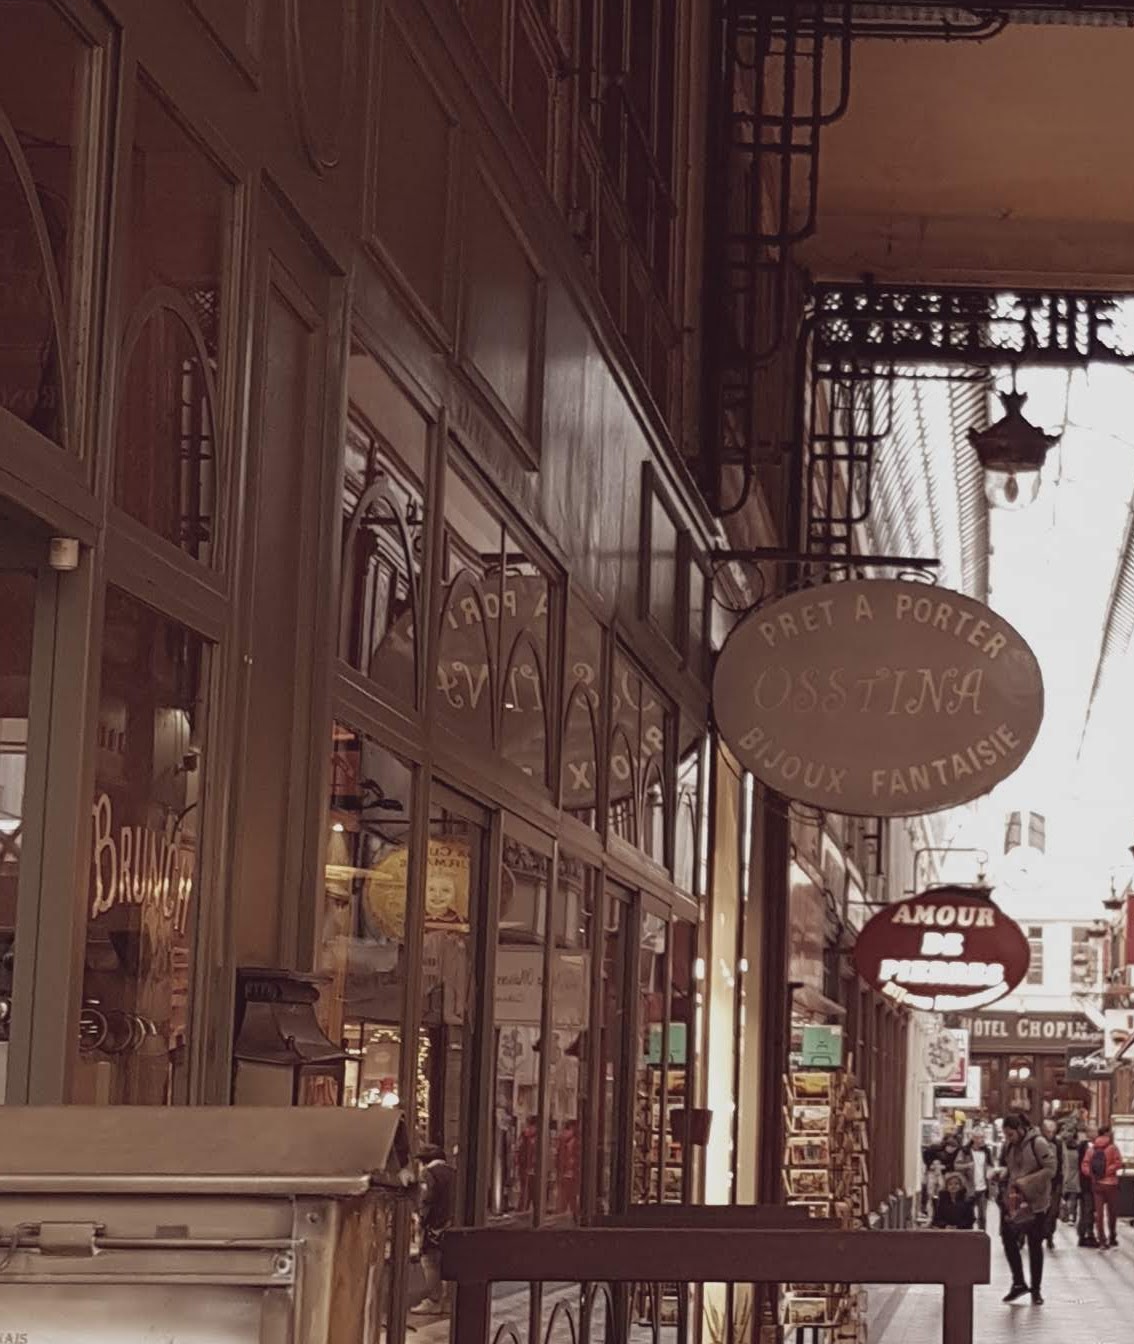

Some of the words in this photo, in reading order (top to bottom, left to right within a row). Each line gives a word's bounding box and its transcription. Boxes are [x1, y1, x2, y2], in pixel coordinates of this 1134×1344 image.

[1017, 296, 1111, 356] THE
[760, 599, 834, 647] PRET
[854, 594, 874, 622] A
[895, 593, 1008, 660] PORTER
[738, 726, 848, 794] BIJOUX
[871, 723, 1021, 797] FANTAISIE
[891, 904, 996, 927] AMOUR
